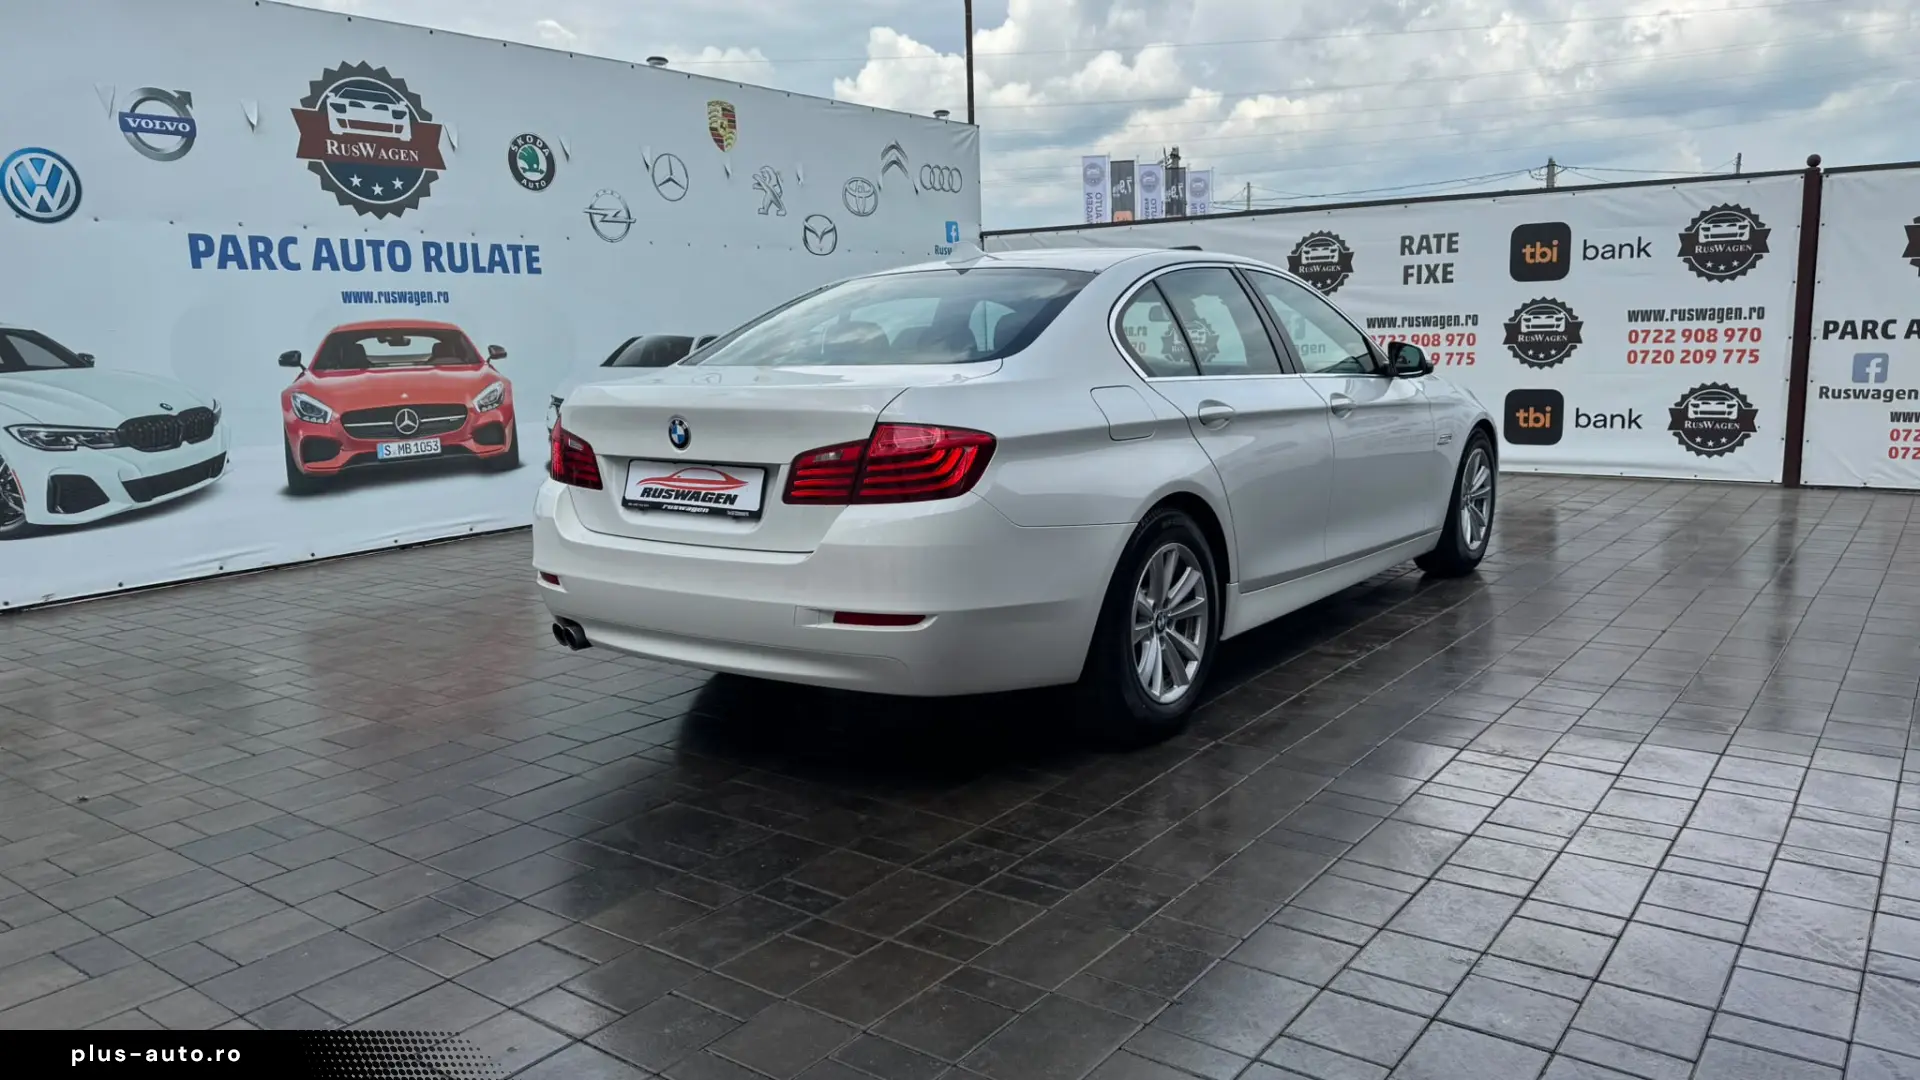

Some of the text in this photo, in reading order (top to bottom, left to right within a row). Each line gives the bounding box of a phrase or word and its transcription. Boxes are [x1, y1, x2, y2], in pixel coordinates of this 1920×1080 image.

[124, 116, 191, 134] VOLVO
[325, 138, 419, 163] RUSWAGEN
[521, 178, 547, 189] AUTO
[1400, 232, 1460, 256] RATE
[1521, 236, 1652, 265] tbi bank
[1694, 242, 1753, 256] RUSWAGEN
[187, 232, 542, 275] PARC AUTO RULATE
[1298, 263, 1341, 274] RUSWAGEN
[1403, 262, 1455, 286] FIXE
[341, 290, 450, 307] www.ruswagen.ro
[1366, 313, 1479, 330] www.ruswagen.ro
[1627, 305, 1766, 323] www.ruswagen.ro
[1517, 332, 1568, 344] RUSWAGEN
[1627, 326, 1763, 345] 0722 908 970
[1821, 318, 1920, 341] PARC A
[1410, 333, 1441, 347] 908
[1445, 332, 1477, 347] 970
[1445, 351, 1476, 366] 775
[1626, 348, 1760, 365] 0720 209 775
[1818, 385, 1919, 403] Ruswagen
[1515, 405, 1643, 430] tbi bank
[1684, 419, 1740, 431] RUSWAGEN
[384, 444, 391, 456] S
[414, 440, 439, 454] 1053
[640, 486, 740, 506] RUSWAGEN
[662, 503, 710, 514] ruswagen
